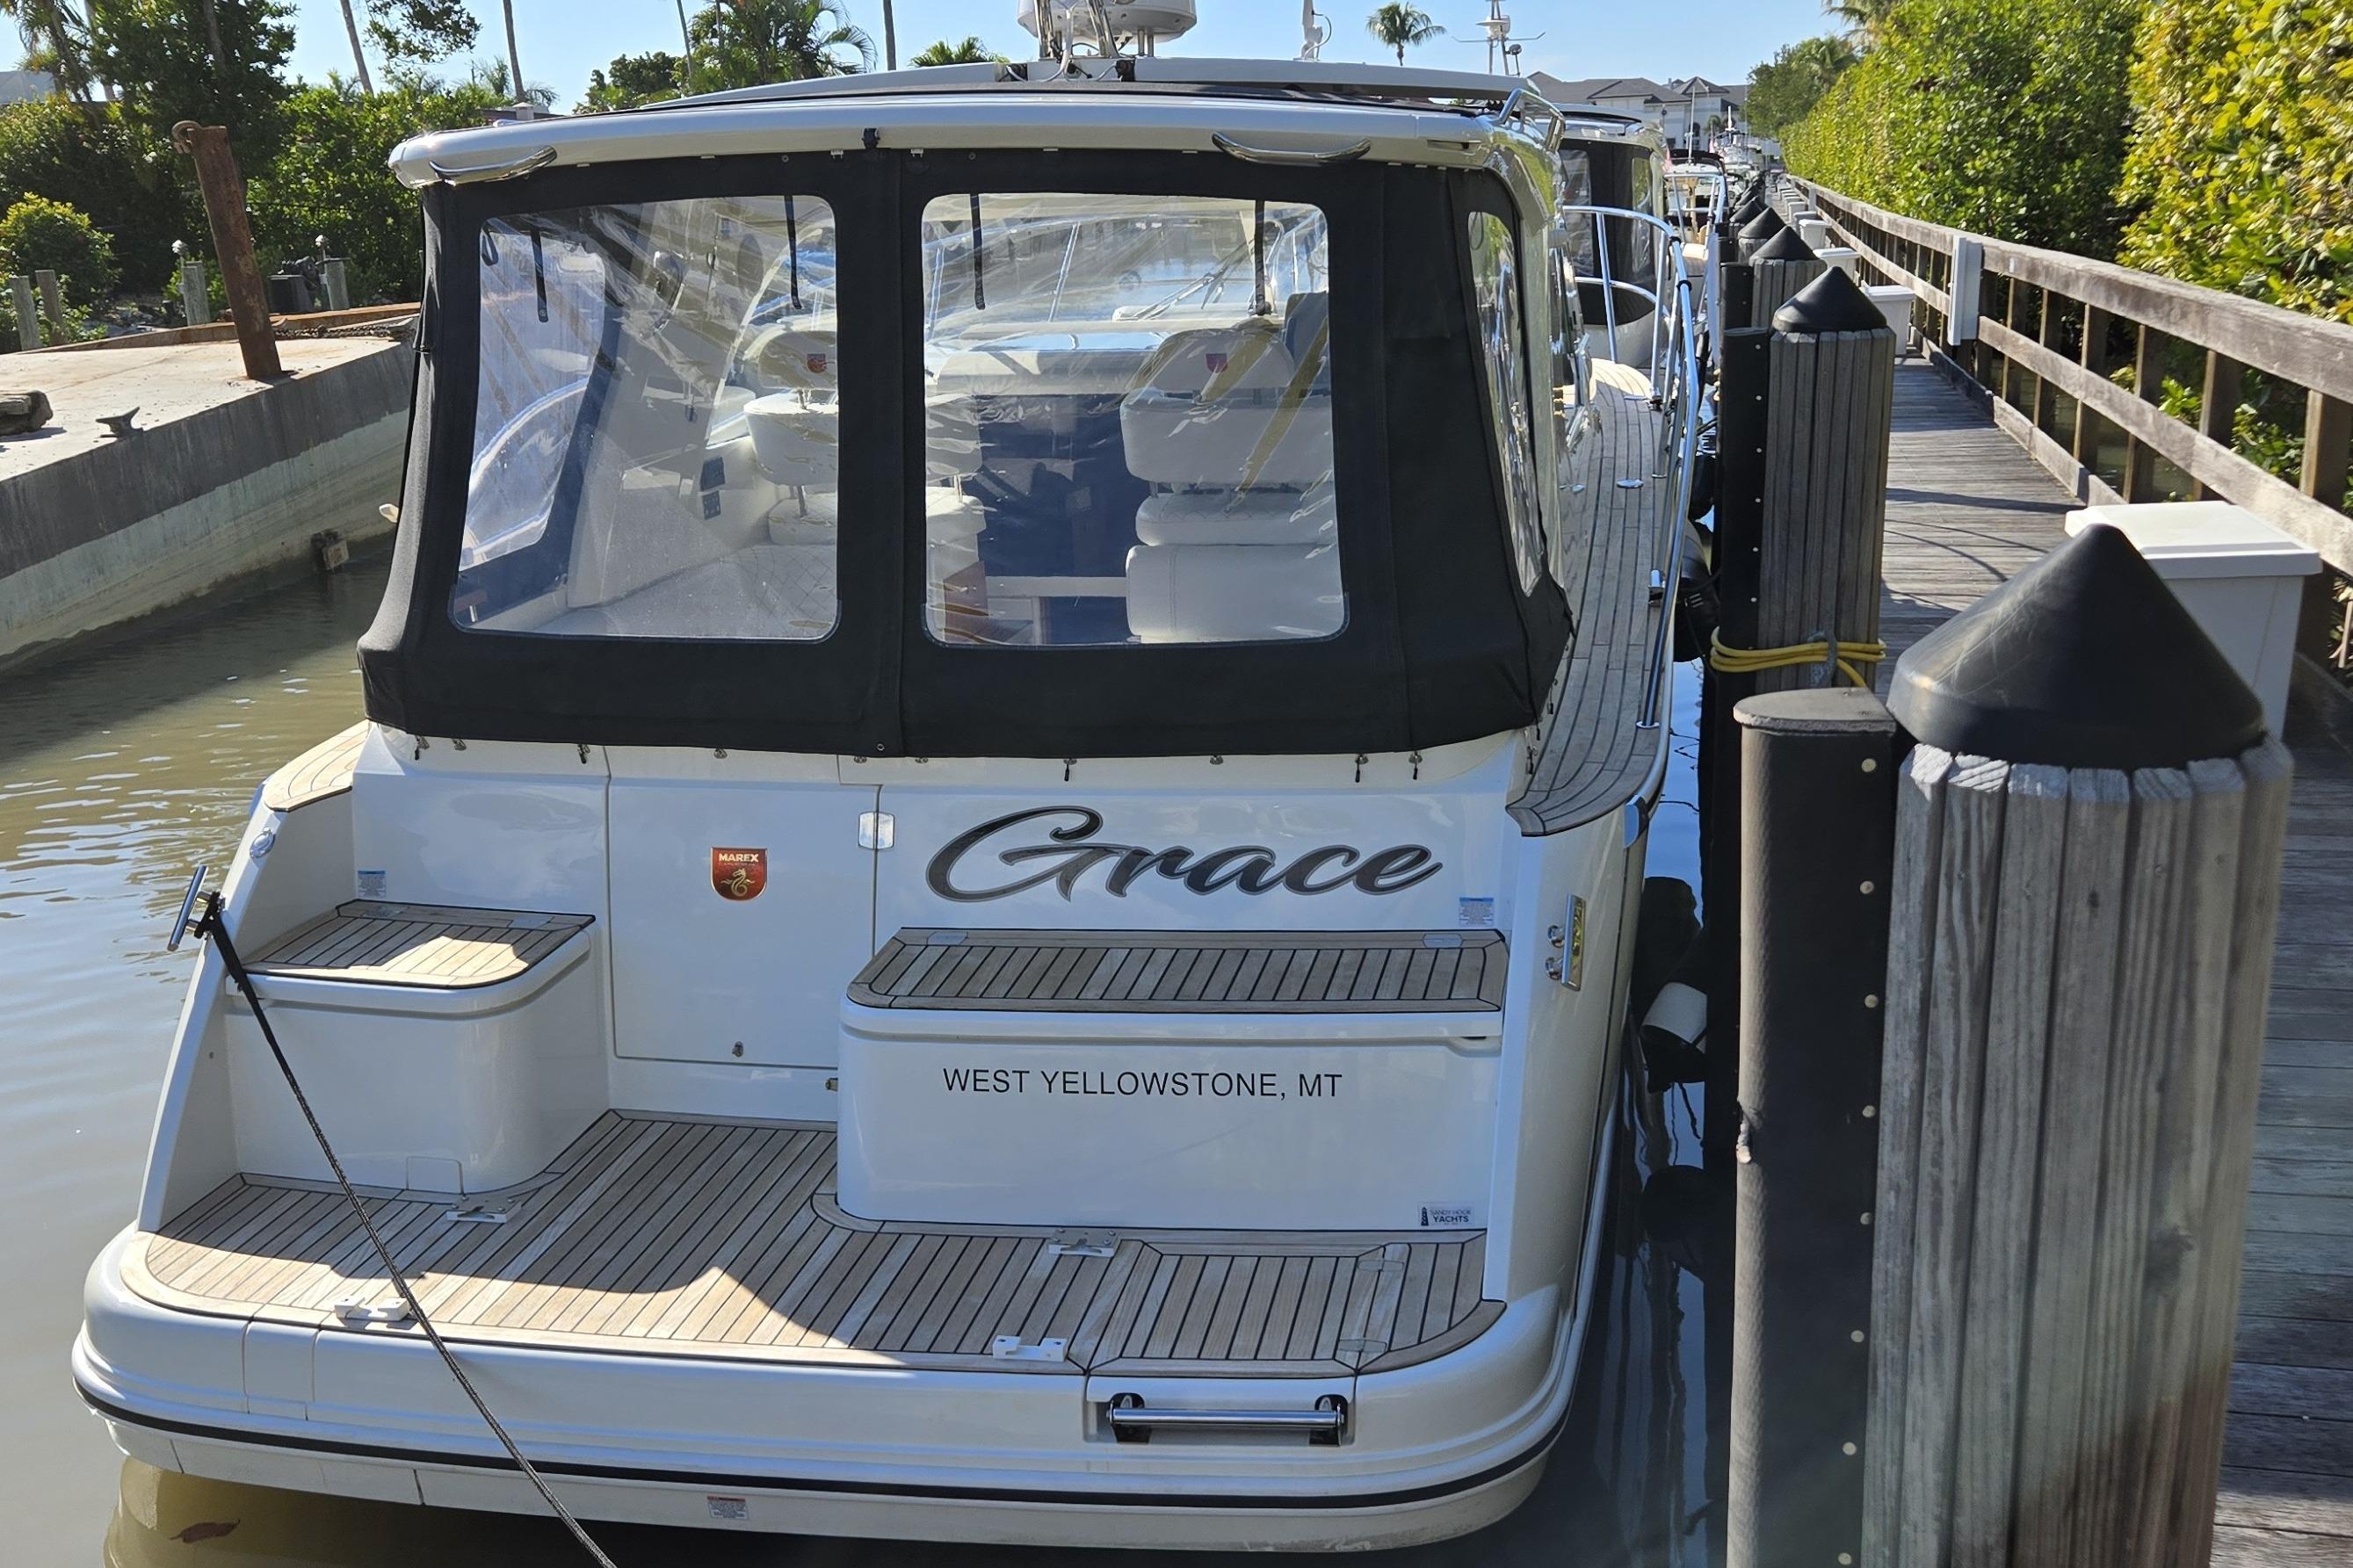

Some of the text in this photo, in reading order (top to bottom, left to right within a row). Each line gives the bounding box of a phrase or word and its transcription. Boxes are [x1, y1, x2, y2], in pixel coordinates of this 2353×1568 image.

[718, 853, 759, 863] MAREX
[925, 806, 1443, 902] Grace
[943, 1067, 1343, 1100] WEST YELLOWSTONE, MT
